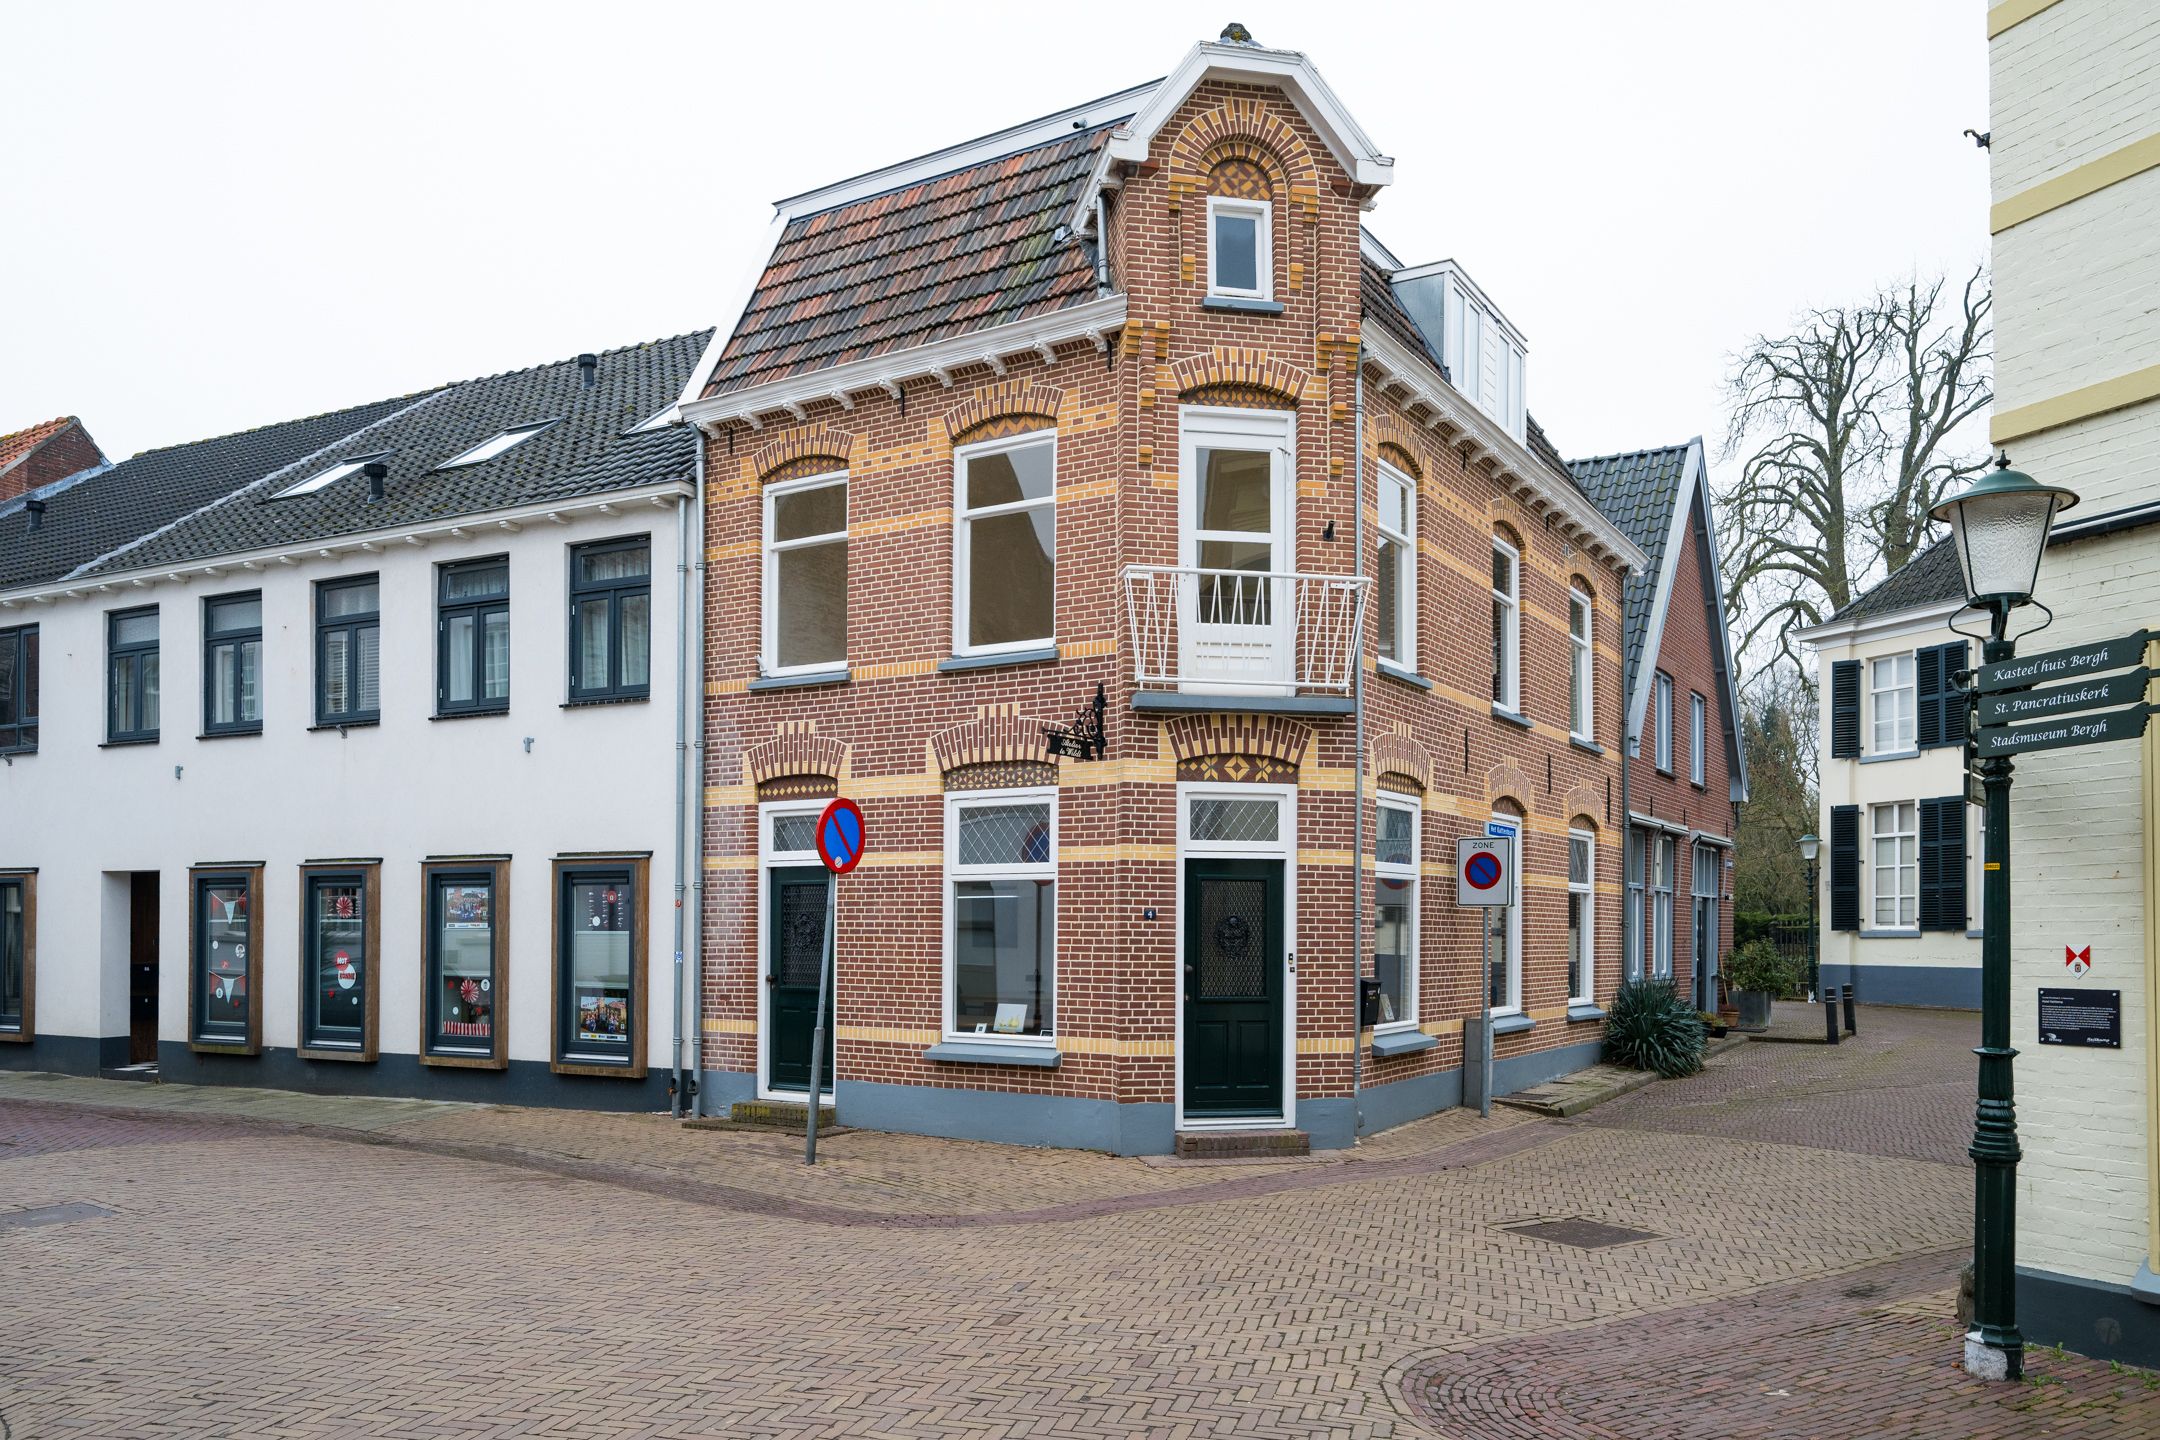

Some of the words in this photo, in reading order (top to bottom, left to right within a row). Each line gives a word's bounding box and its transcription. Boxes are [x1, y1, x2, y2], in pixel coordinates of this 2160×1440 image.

[1993, 661, 2039, 682] Kasteel
[2040, 659, 2066, 673] huis
[2070, 648, 2109, 667] Bergh
[1994, 703, 2009, 715] St.
[2013, 684, 2110, 712] Pancratiuskerk
[1991, 730, 2067, 748] Stadsmuseum
[2071, 719, 2107, 738] Bergh
[1472, 841, 1495, 849] ZONE
[1147, 910, 1153, 919] 4
